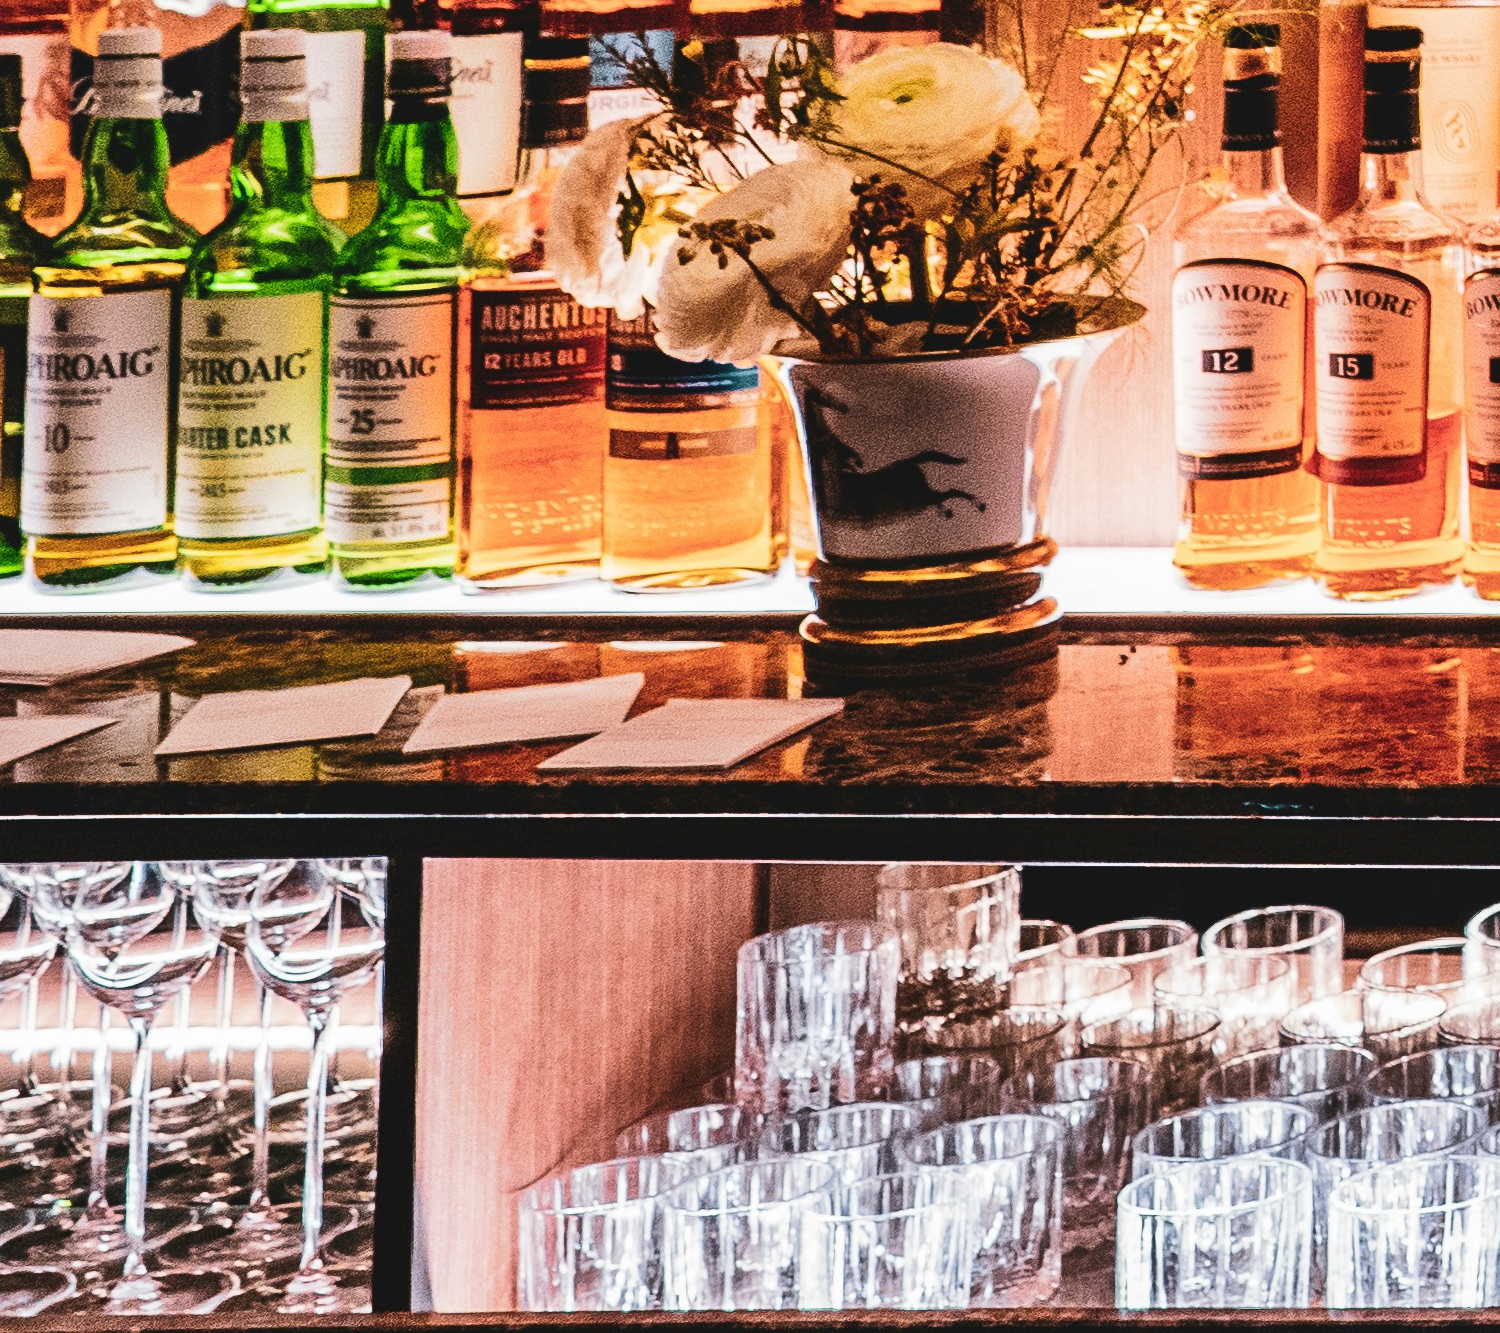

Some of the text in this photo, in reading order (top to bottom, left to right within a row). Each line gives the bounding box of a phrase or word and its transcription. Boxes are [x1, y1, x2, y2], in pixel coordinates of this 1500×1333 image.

[1176, 283, 1296, 311] BOWMORE
[1316, 286, 1418, 319] OWMORE
[480, 301, 605, 332] AUCHENTOS
[28, 345, 162, 383] PHROAIG
[180, 347, 312, 386] PHROAIG
[332, 354, 441, 382] PHROAIG
[504, 350, 551, 369] YEARS
[556, 347, 588, 366] OLD
[1211, 350, 1240, 373] 12
[1337, 356, 1360, 377] 15
[350, 407, 377, 435] 25
[44, 422, 71, 454] 10
[235, 422, 293, 449] CASK
